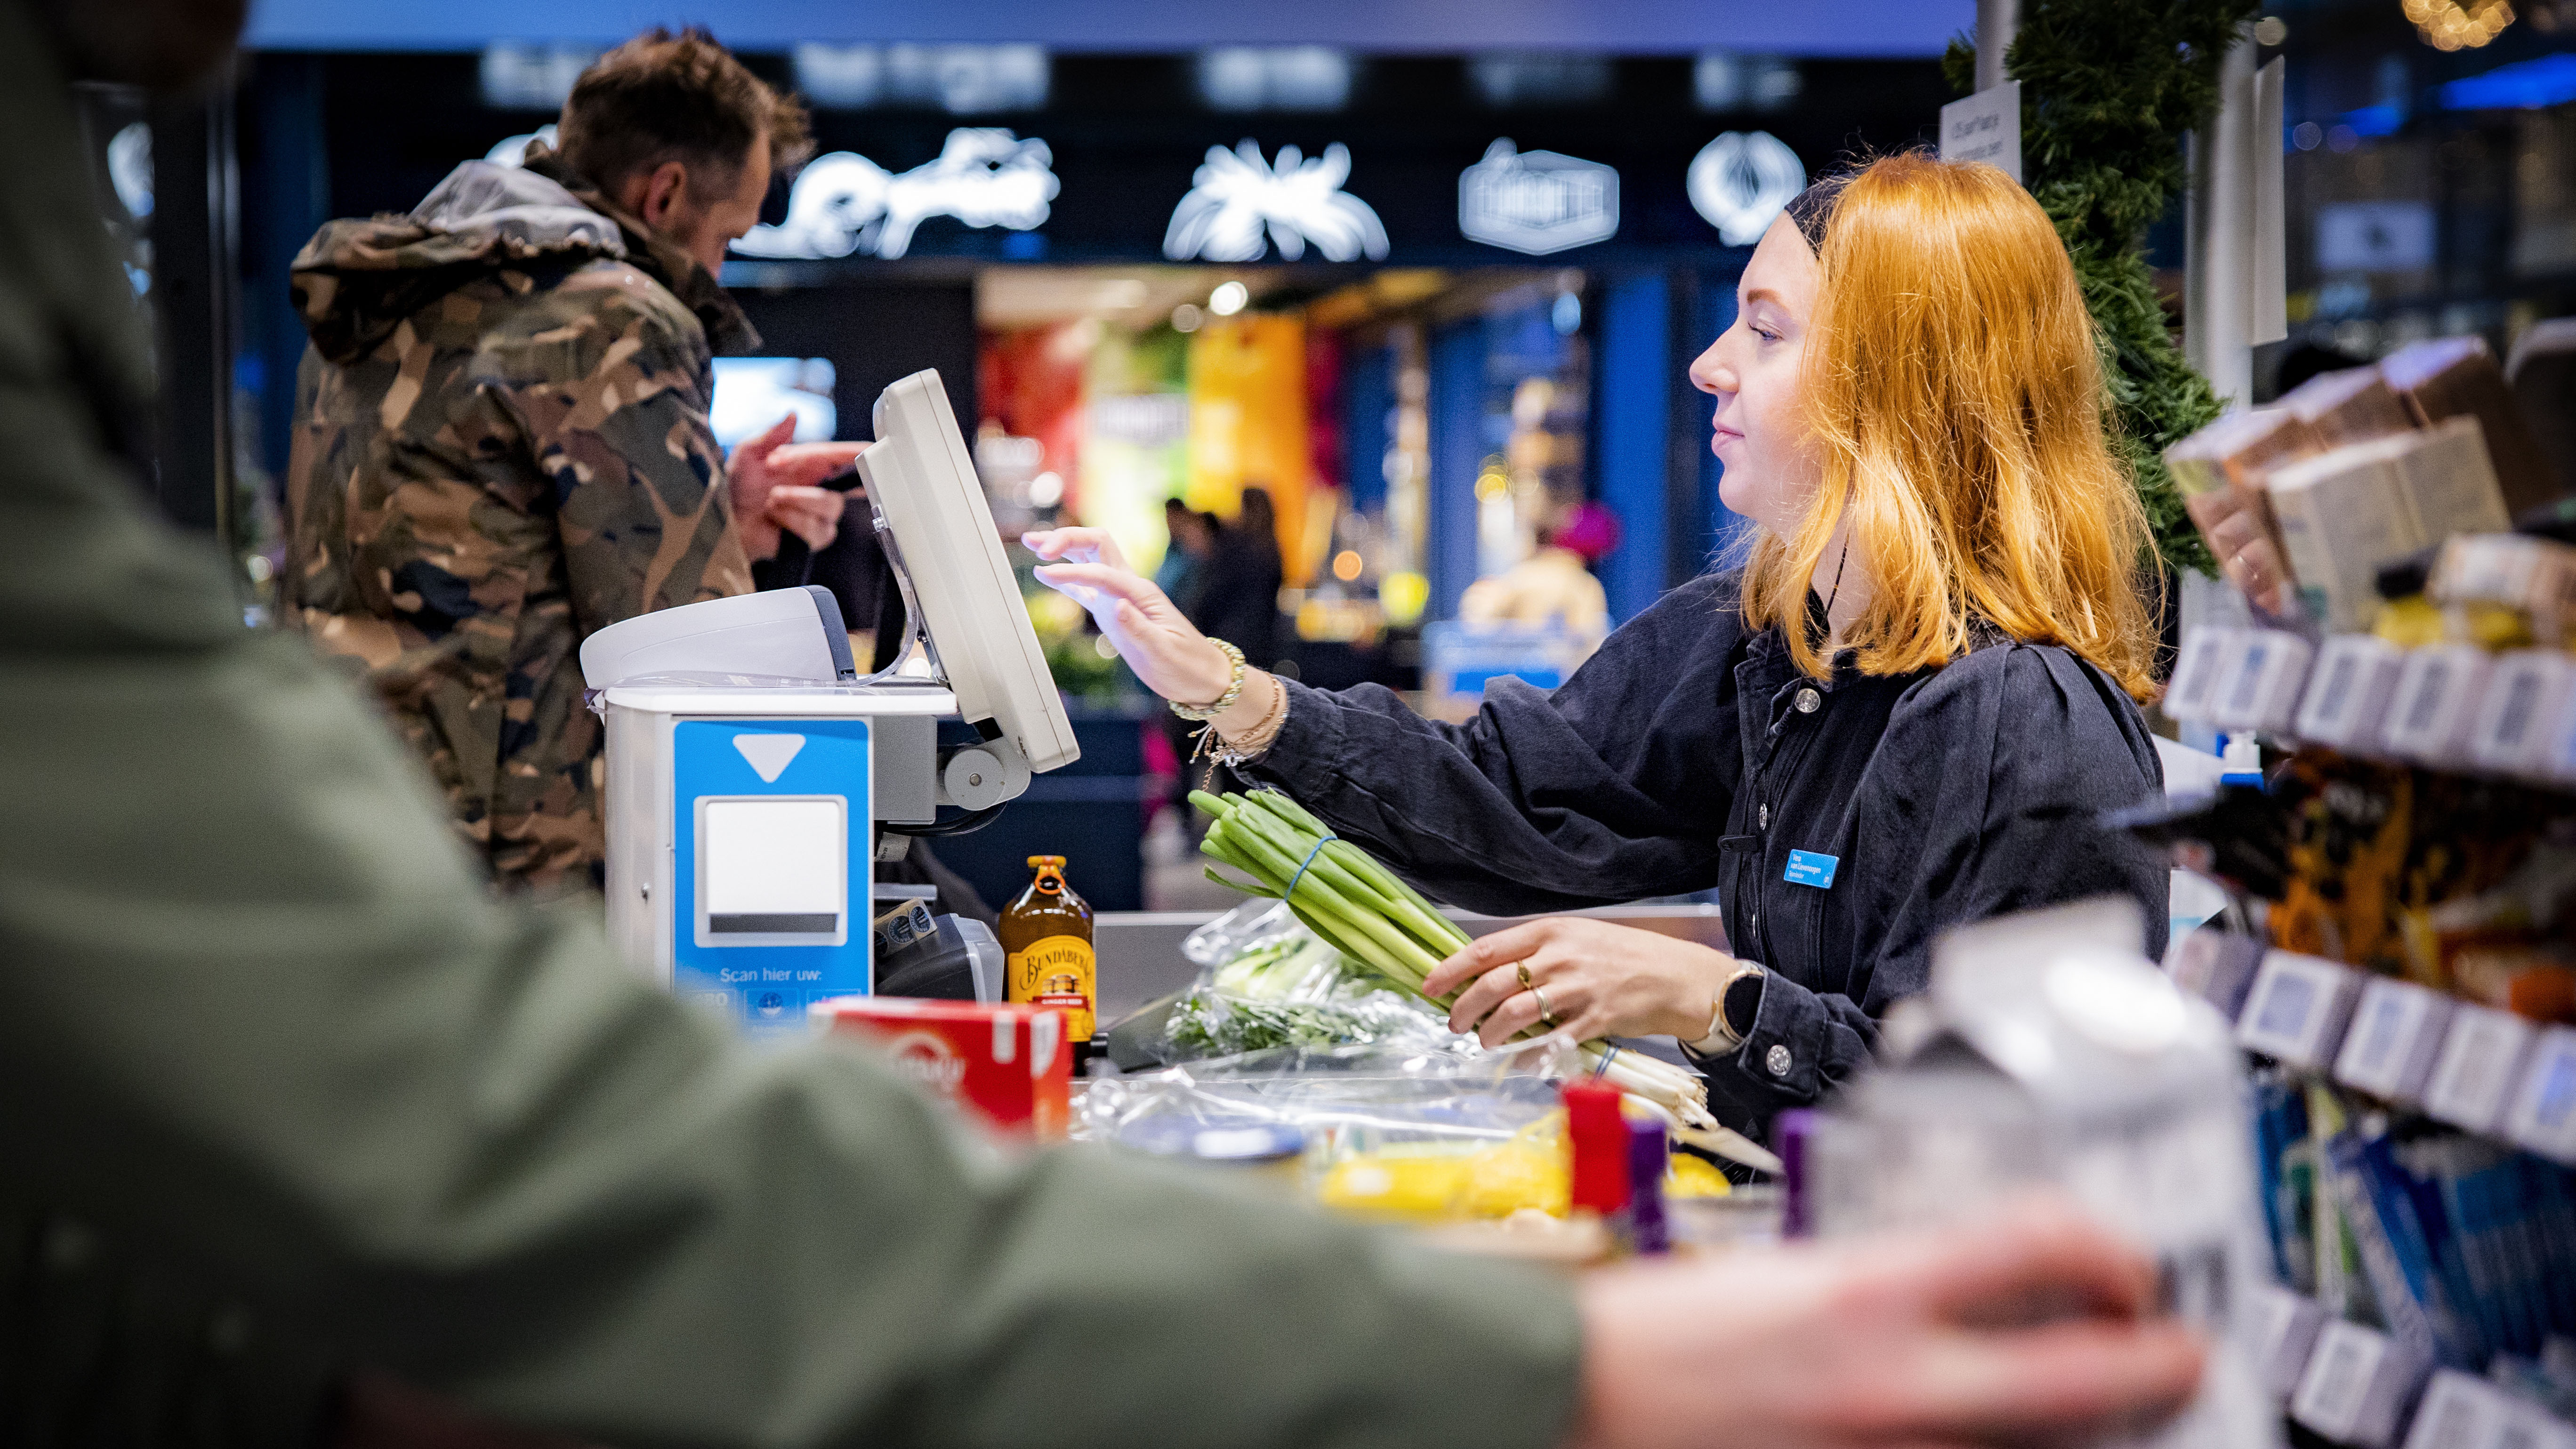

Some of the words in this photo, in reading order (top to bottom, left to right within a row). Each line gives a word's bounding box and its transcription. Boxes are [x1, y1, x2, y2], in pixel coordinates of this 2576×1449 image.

[720, 967, 758, 982] Scan
[763, 967, 792, 981] hier
[1020, 948, 1091, 990] BUNDABERG
